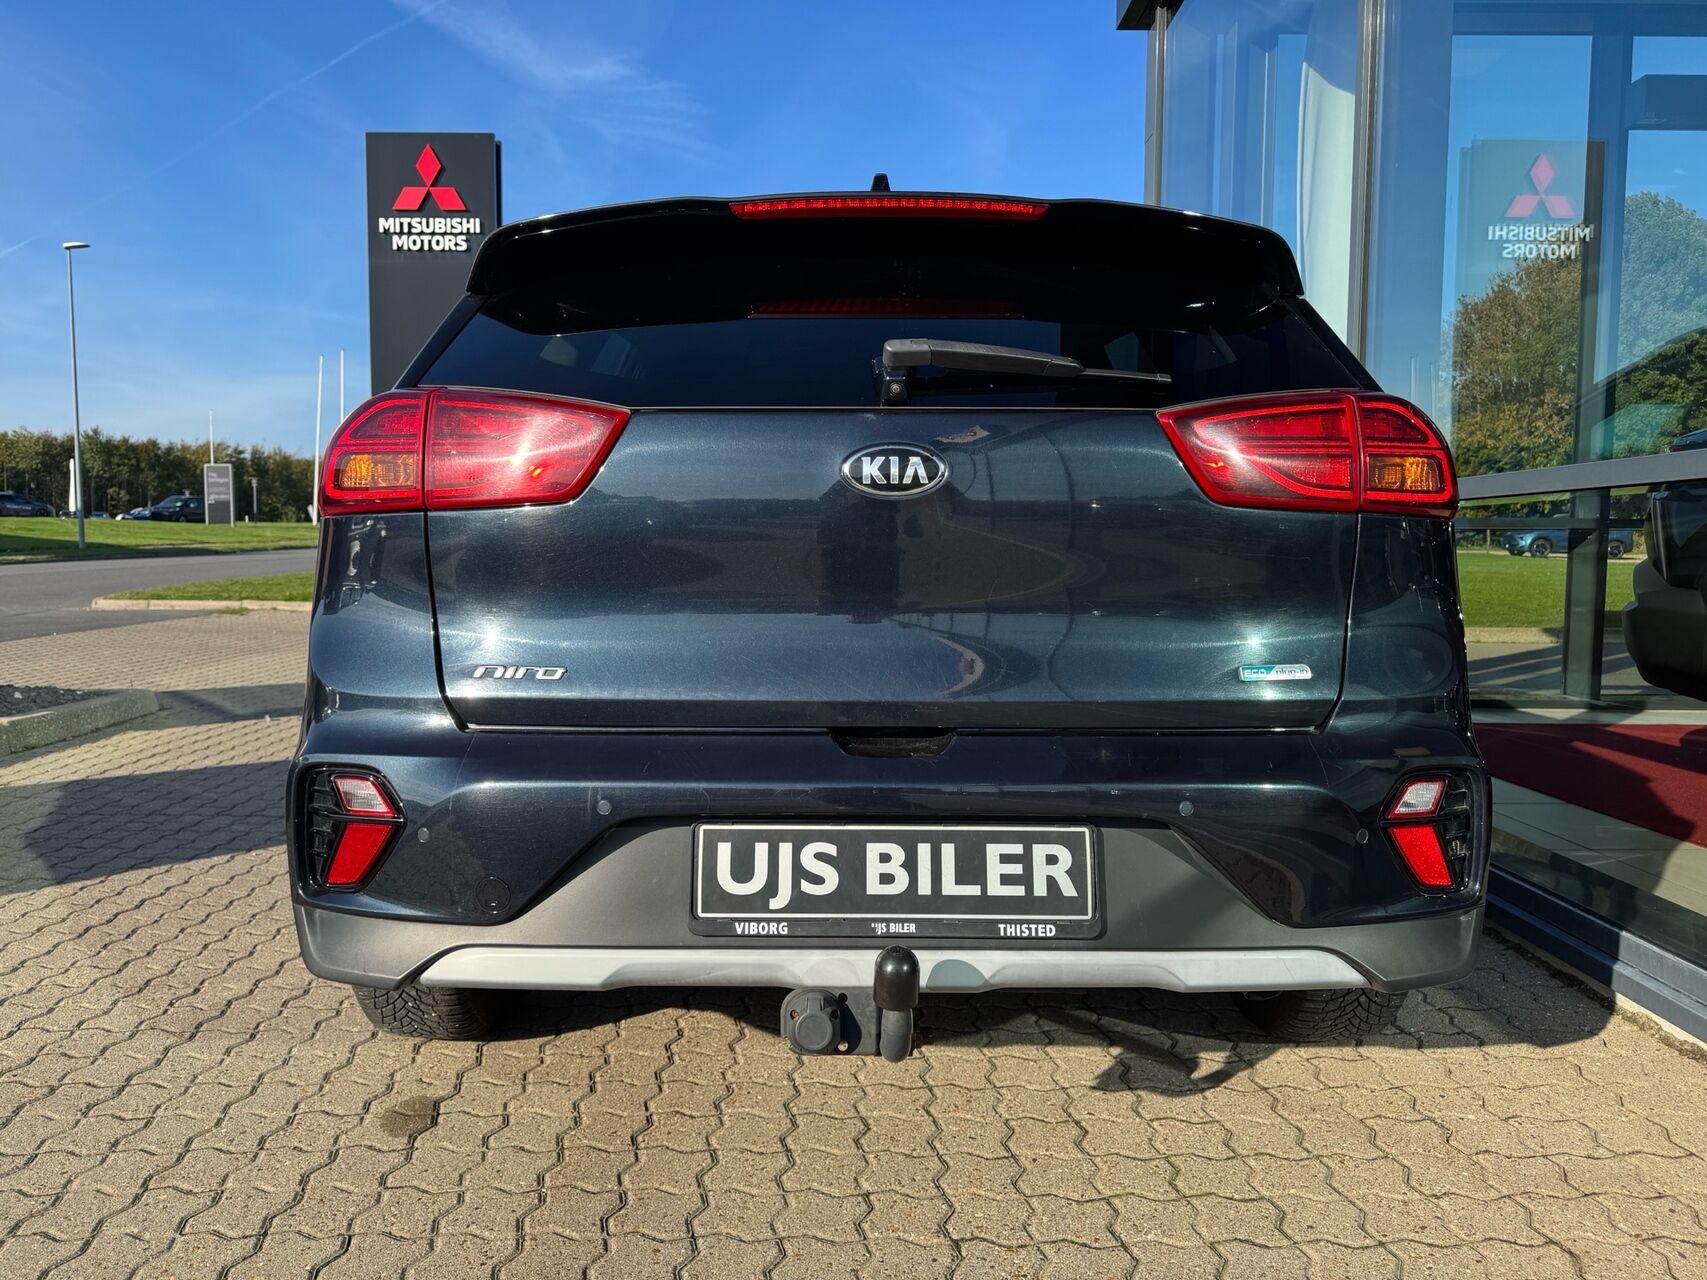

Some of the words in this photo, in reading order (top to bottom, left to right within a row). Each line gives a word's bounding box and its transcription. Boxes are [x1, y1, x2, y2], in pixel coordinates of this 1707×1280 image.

[378, 217, 481, 234] MITSUBISHI
[391, 234, 468, 251] MOTORS
[861, 456, 929, 484] KIA
[716, 841, 840, 910] UJS
[865, 842, 1079, 897] BILER
[734, 922, 789, 935] VIBORG
[889, 922, 916, 933] BILER
[998, 923, 1057, 937] THISTED
